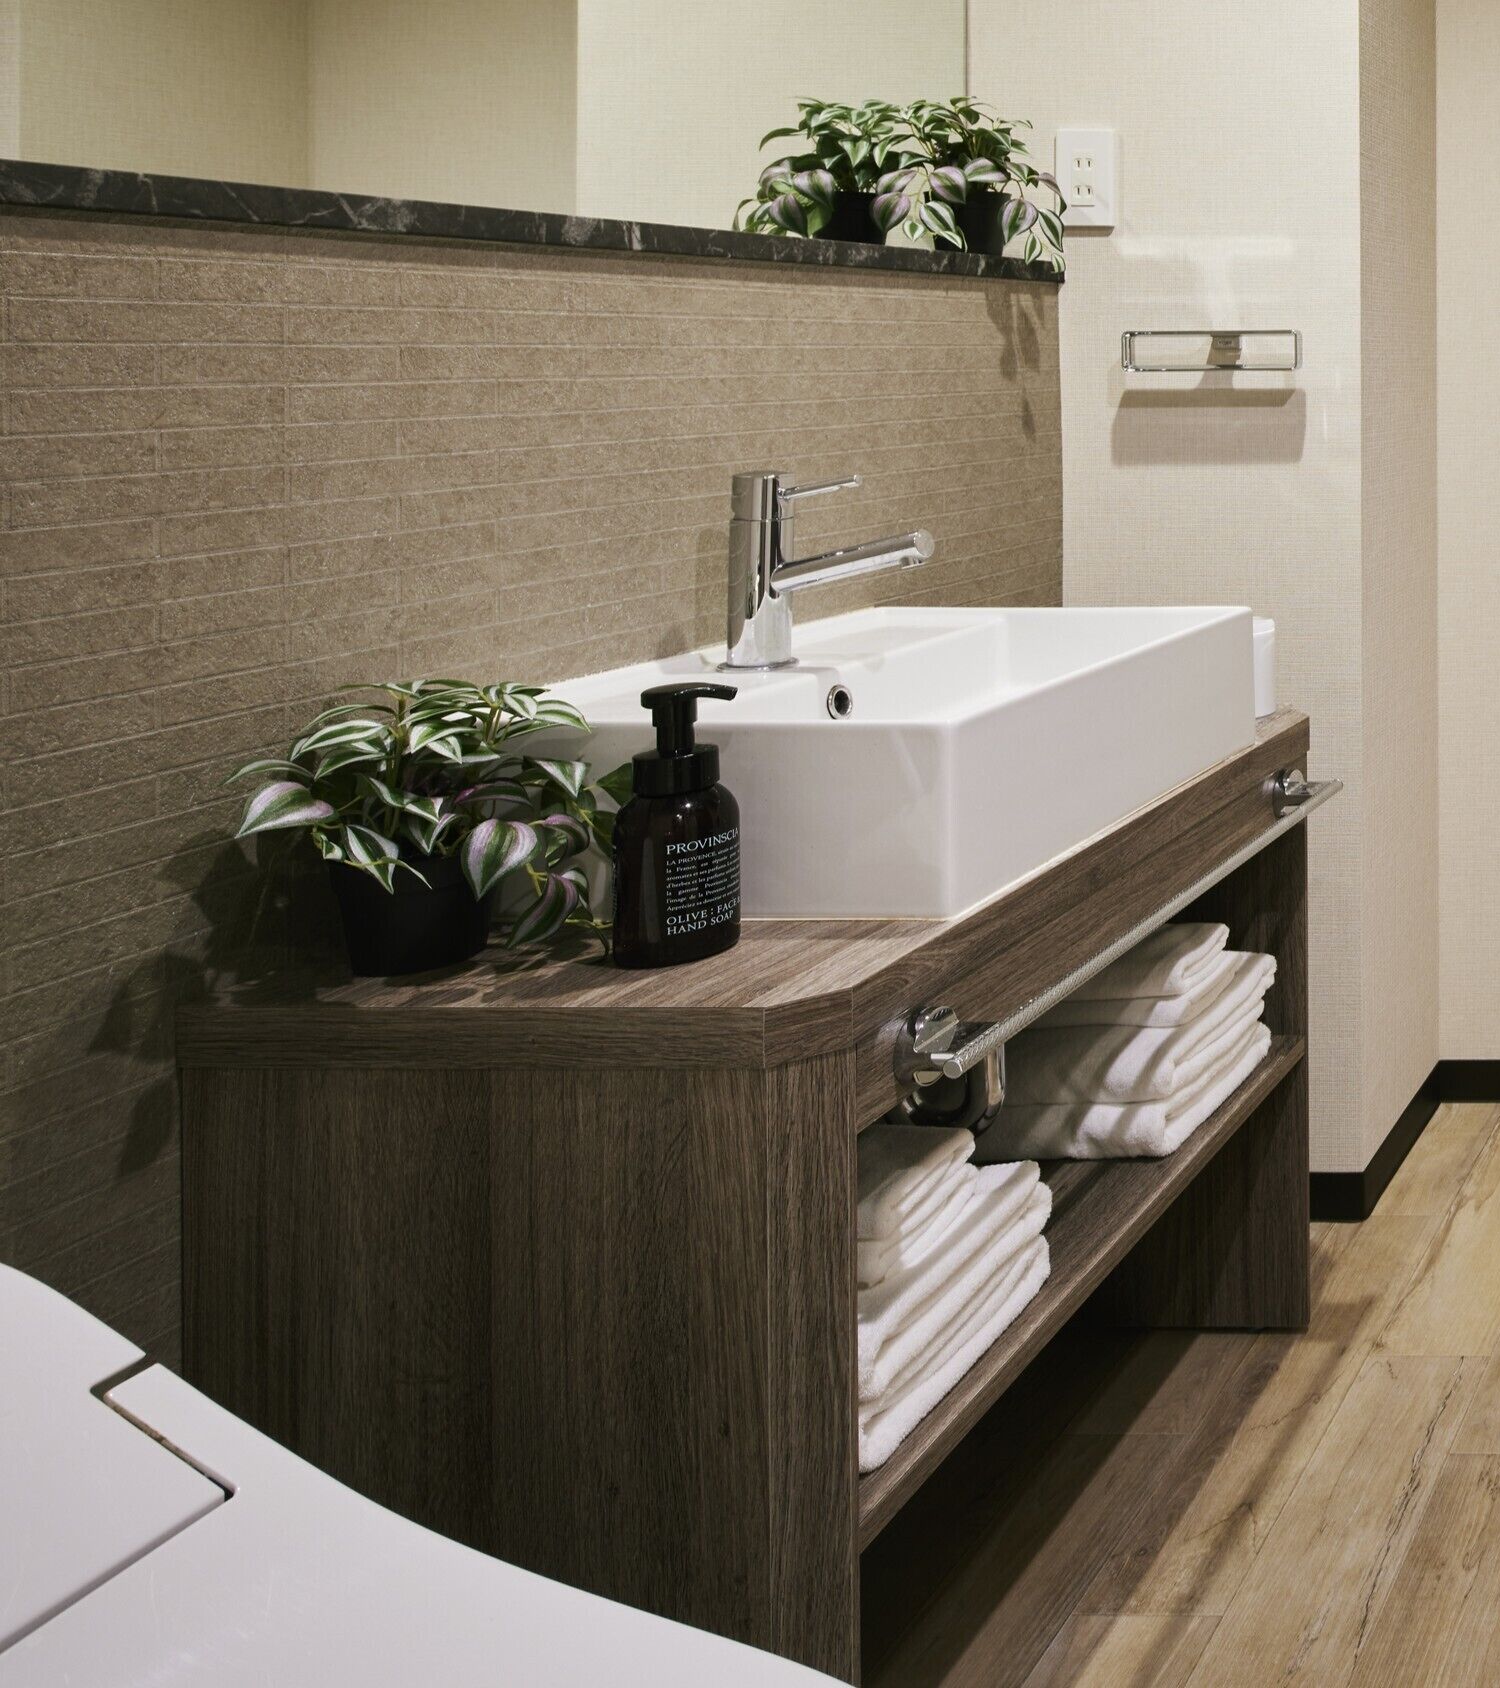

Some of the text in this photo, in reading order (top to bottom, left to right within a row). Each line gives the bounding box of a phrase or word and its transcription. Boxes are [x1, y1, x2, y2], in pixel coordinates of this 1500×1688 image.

[666, 827, 739, 855] PROVINSCIA
[666, 909, 708, 925] OLIVE
[717, 898, 737, 913] FACE
[667, 910, 734, 935] HAND SOAP
